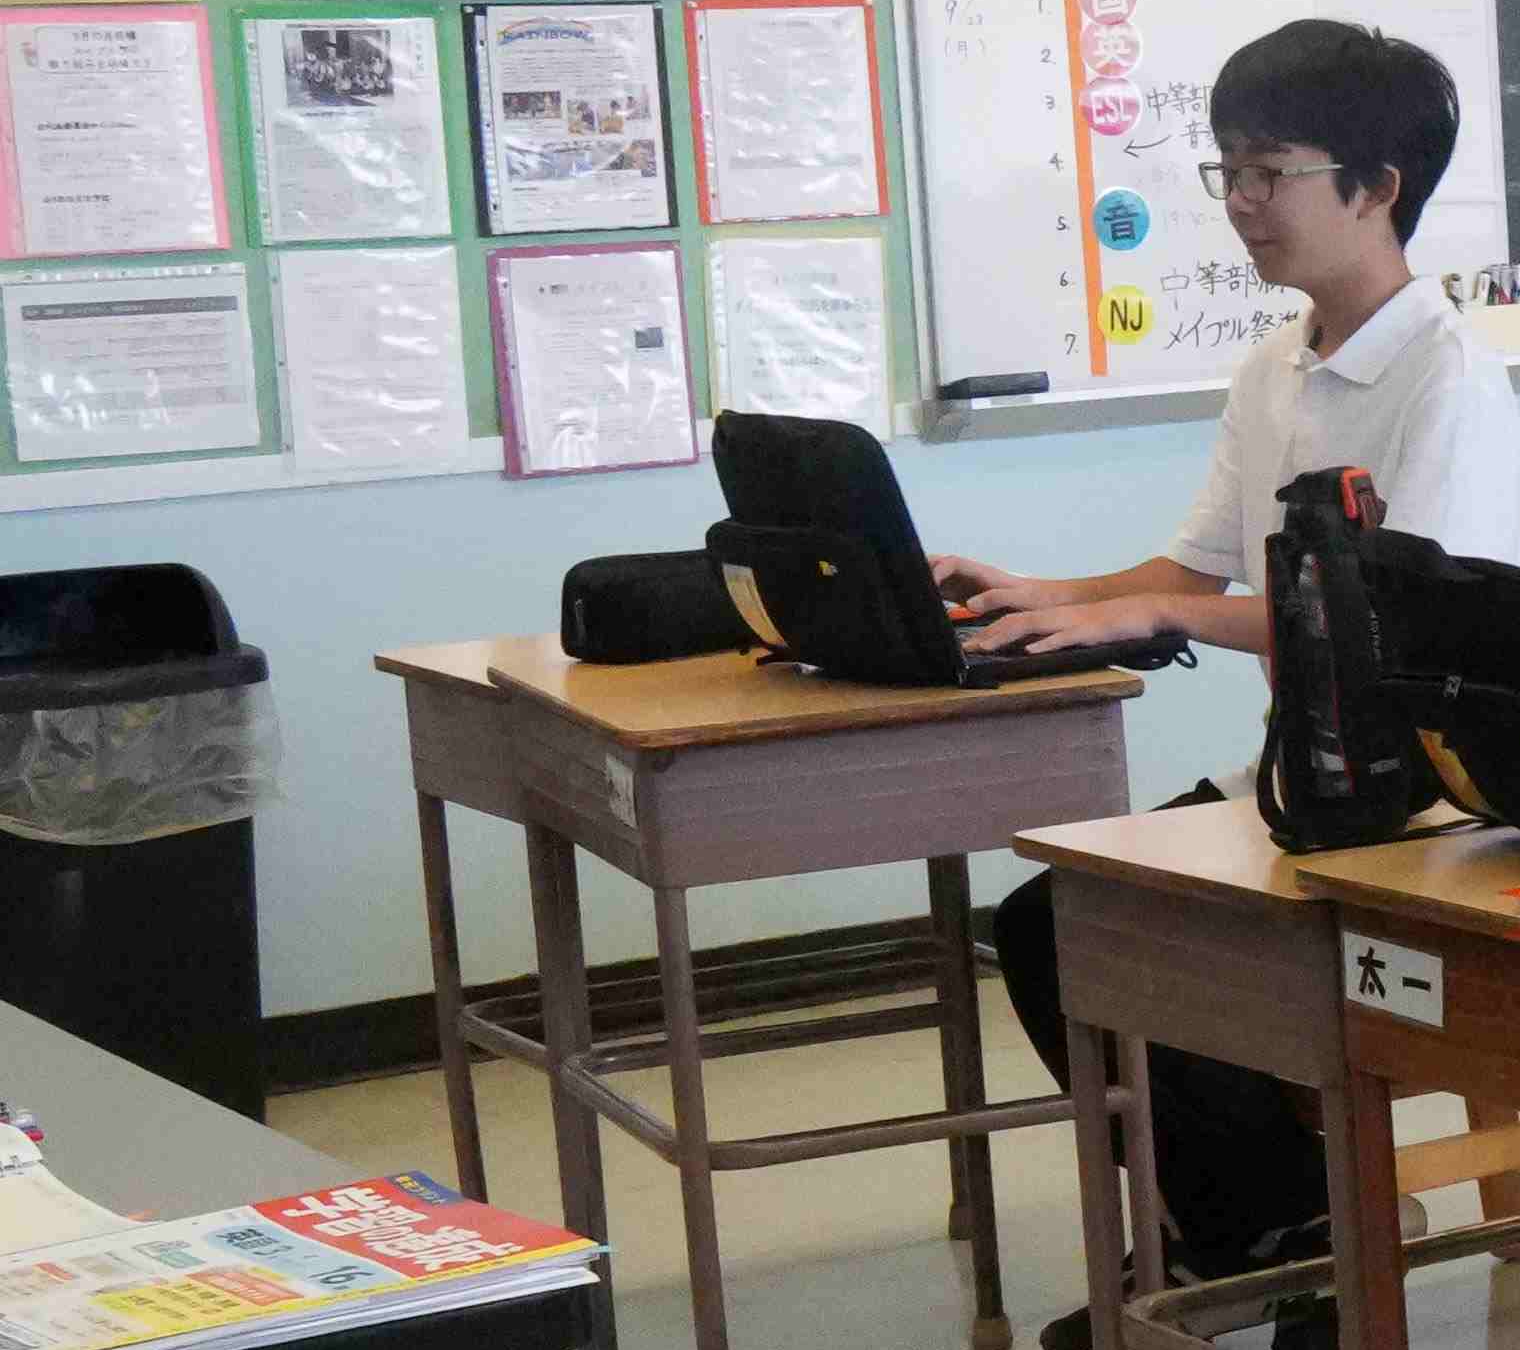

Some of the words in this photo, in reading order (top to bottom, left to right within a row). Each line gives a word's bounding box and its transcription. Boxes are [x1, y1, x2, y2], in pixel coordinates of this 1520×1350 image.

[1092, 95, 1134, 125] ESL
[1103, 201, 1140, 242] 音
[1160, 260, 1287, 310] 中等部
[1110, 300, 1144, 331] NJ
[1356, 946, 1432, 999] 太一
